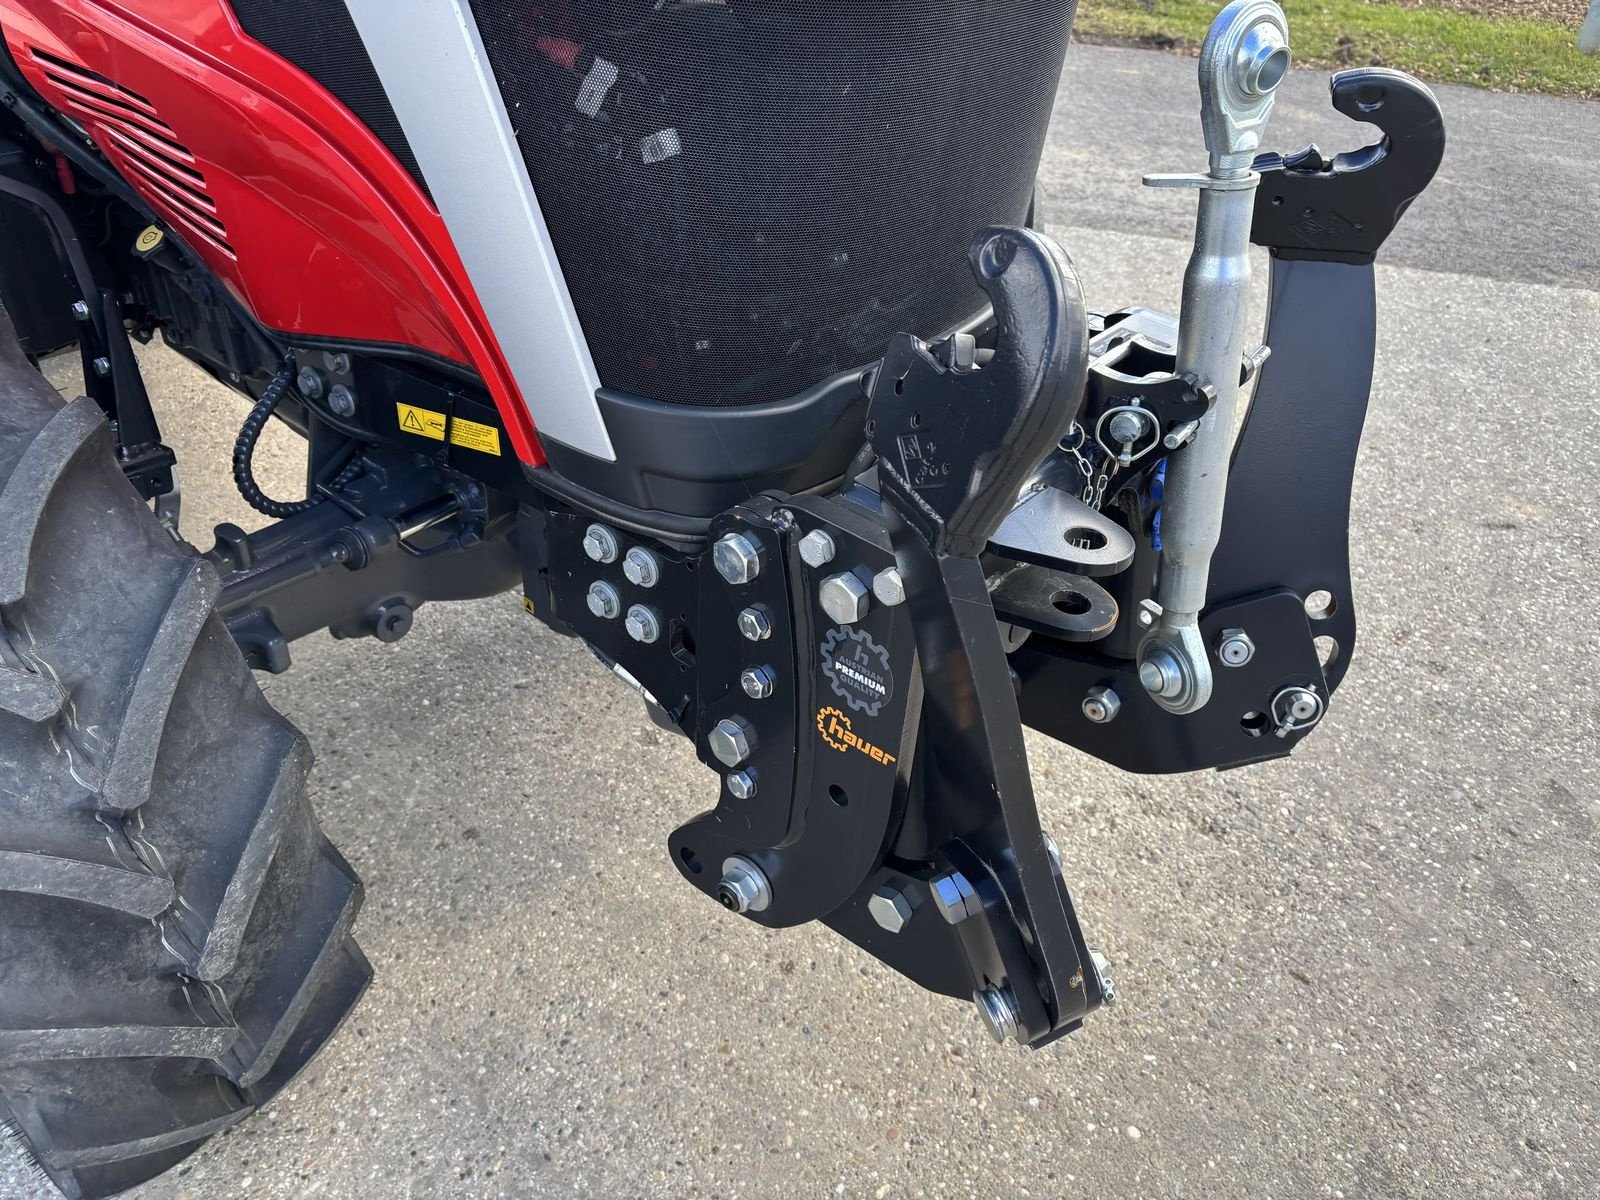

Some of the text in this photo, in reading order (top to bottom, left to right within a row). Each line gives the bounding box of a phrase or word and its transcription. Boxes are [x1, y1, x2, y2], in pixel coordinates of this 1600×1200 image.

[835, 661, 886, 696] PREMIUM
[839, 656, 884, 684] AUSTRIAN
[840, 674, 881, 700] QUALITY
[829, 716, 897, 766] hauer
